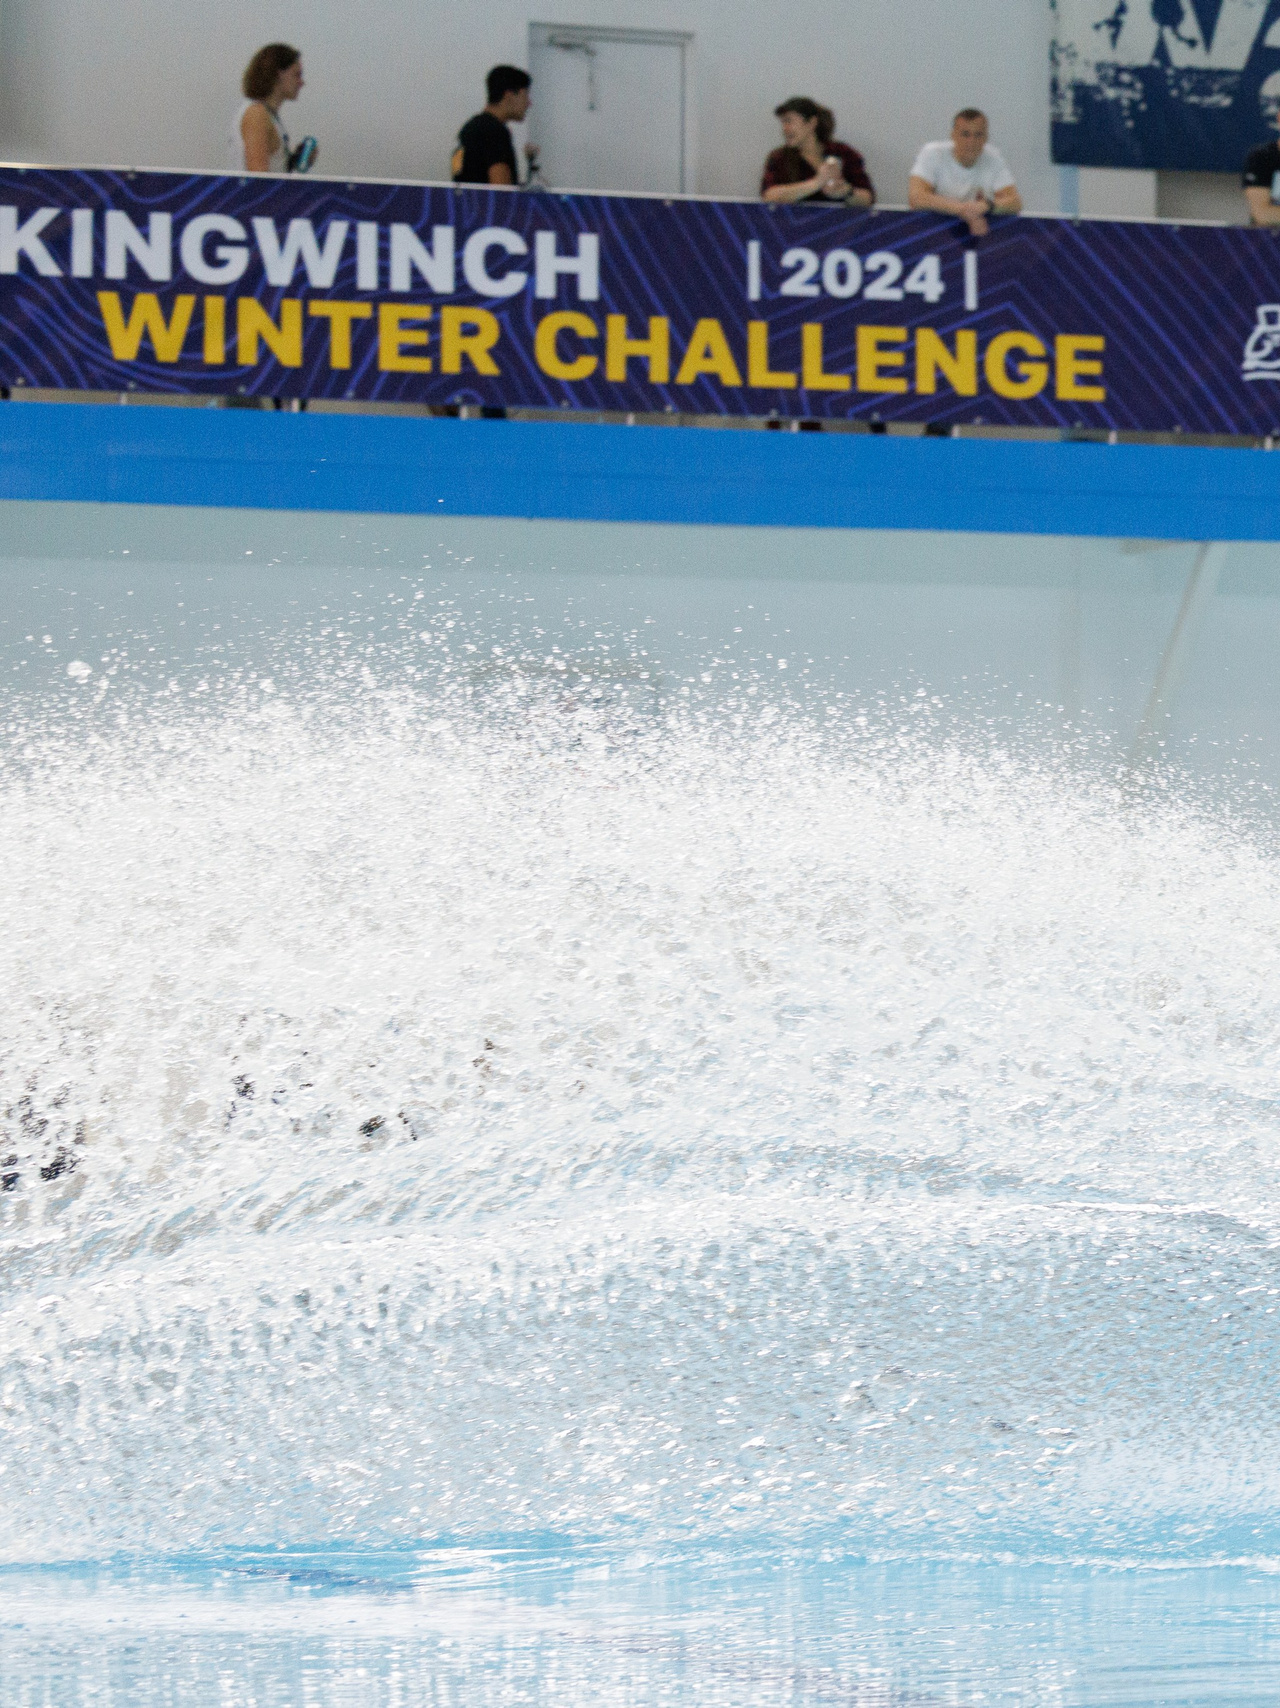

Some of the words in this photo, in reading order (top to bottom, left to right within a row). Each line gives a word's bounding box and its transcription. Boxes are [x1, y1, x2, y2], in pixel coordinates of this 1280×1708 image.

[0, 205, 599, 300] KINGWINCH
[780, 248, 944, 302] 2024
[97, 291, 500, 376] WINTER
[534, 310, 1105, 401] CHALLENGE
